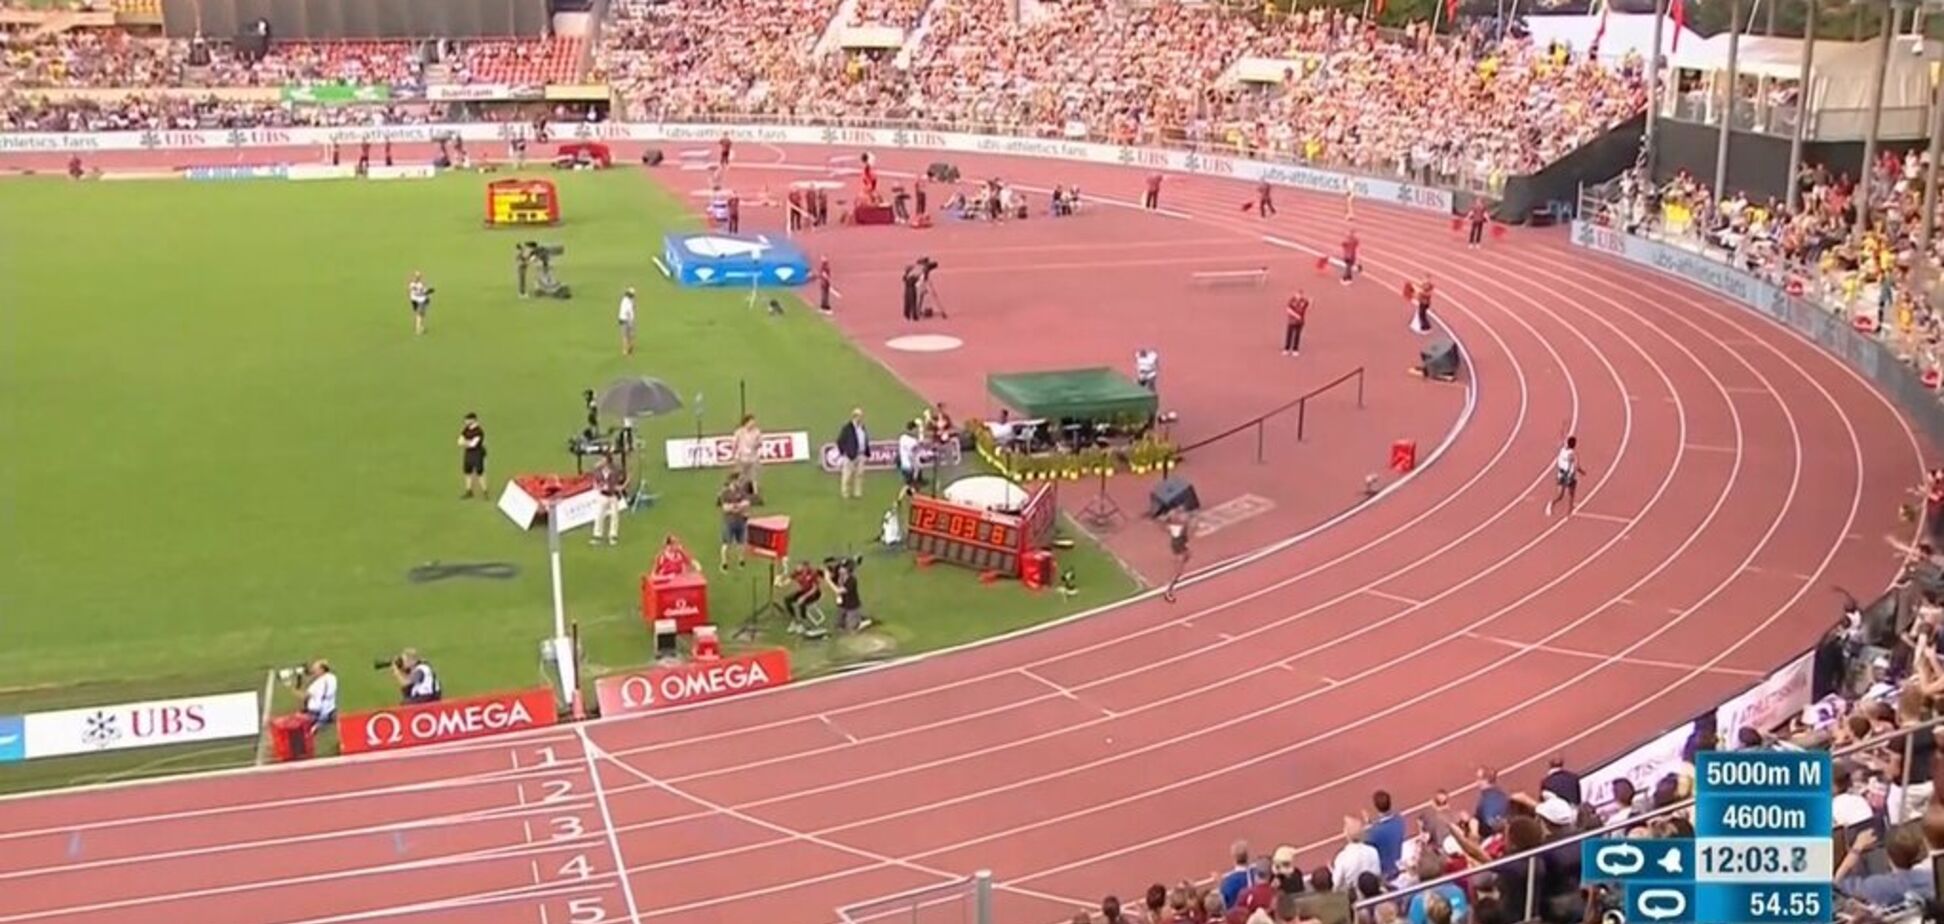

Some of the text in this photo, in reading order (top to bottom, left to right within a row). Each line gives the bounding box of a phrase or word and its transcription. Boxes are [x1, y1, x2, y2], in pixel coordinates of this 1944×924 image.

[165, 129, 206, 145] UBS
[250, 128, 291, 143] UBS
[595, 124, 631, 137] UBS
[842, 130, 876, 143] UBS
[913, 133, 946, 146] UBS
[1138, 150, 1169, 165] UBS
[1203, 158, 1234, 173] UBS
[1414, 187, 1445, 207] UBS
[660, 660, 768, 700] OMEGA
[131, 704, 206, 738] UBS
[410, 700, 532, 743] OMEGA
[535, 747, 558, 767] 1
[541, 780, 573, 803] 2
[550, 816, 584, 840] 3
[557, 855, 594, 880] 4
[568, 897, 606, 924] 5
